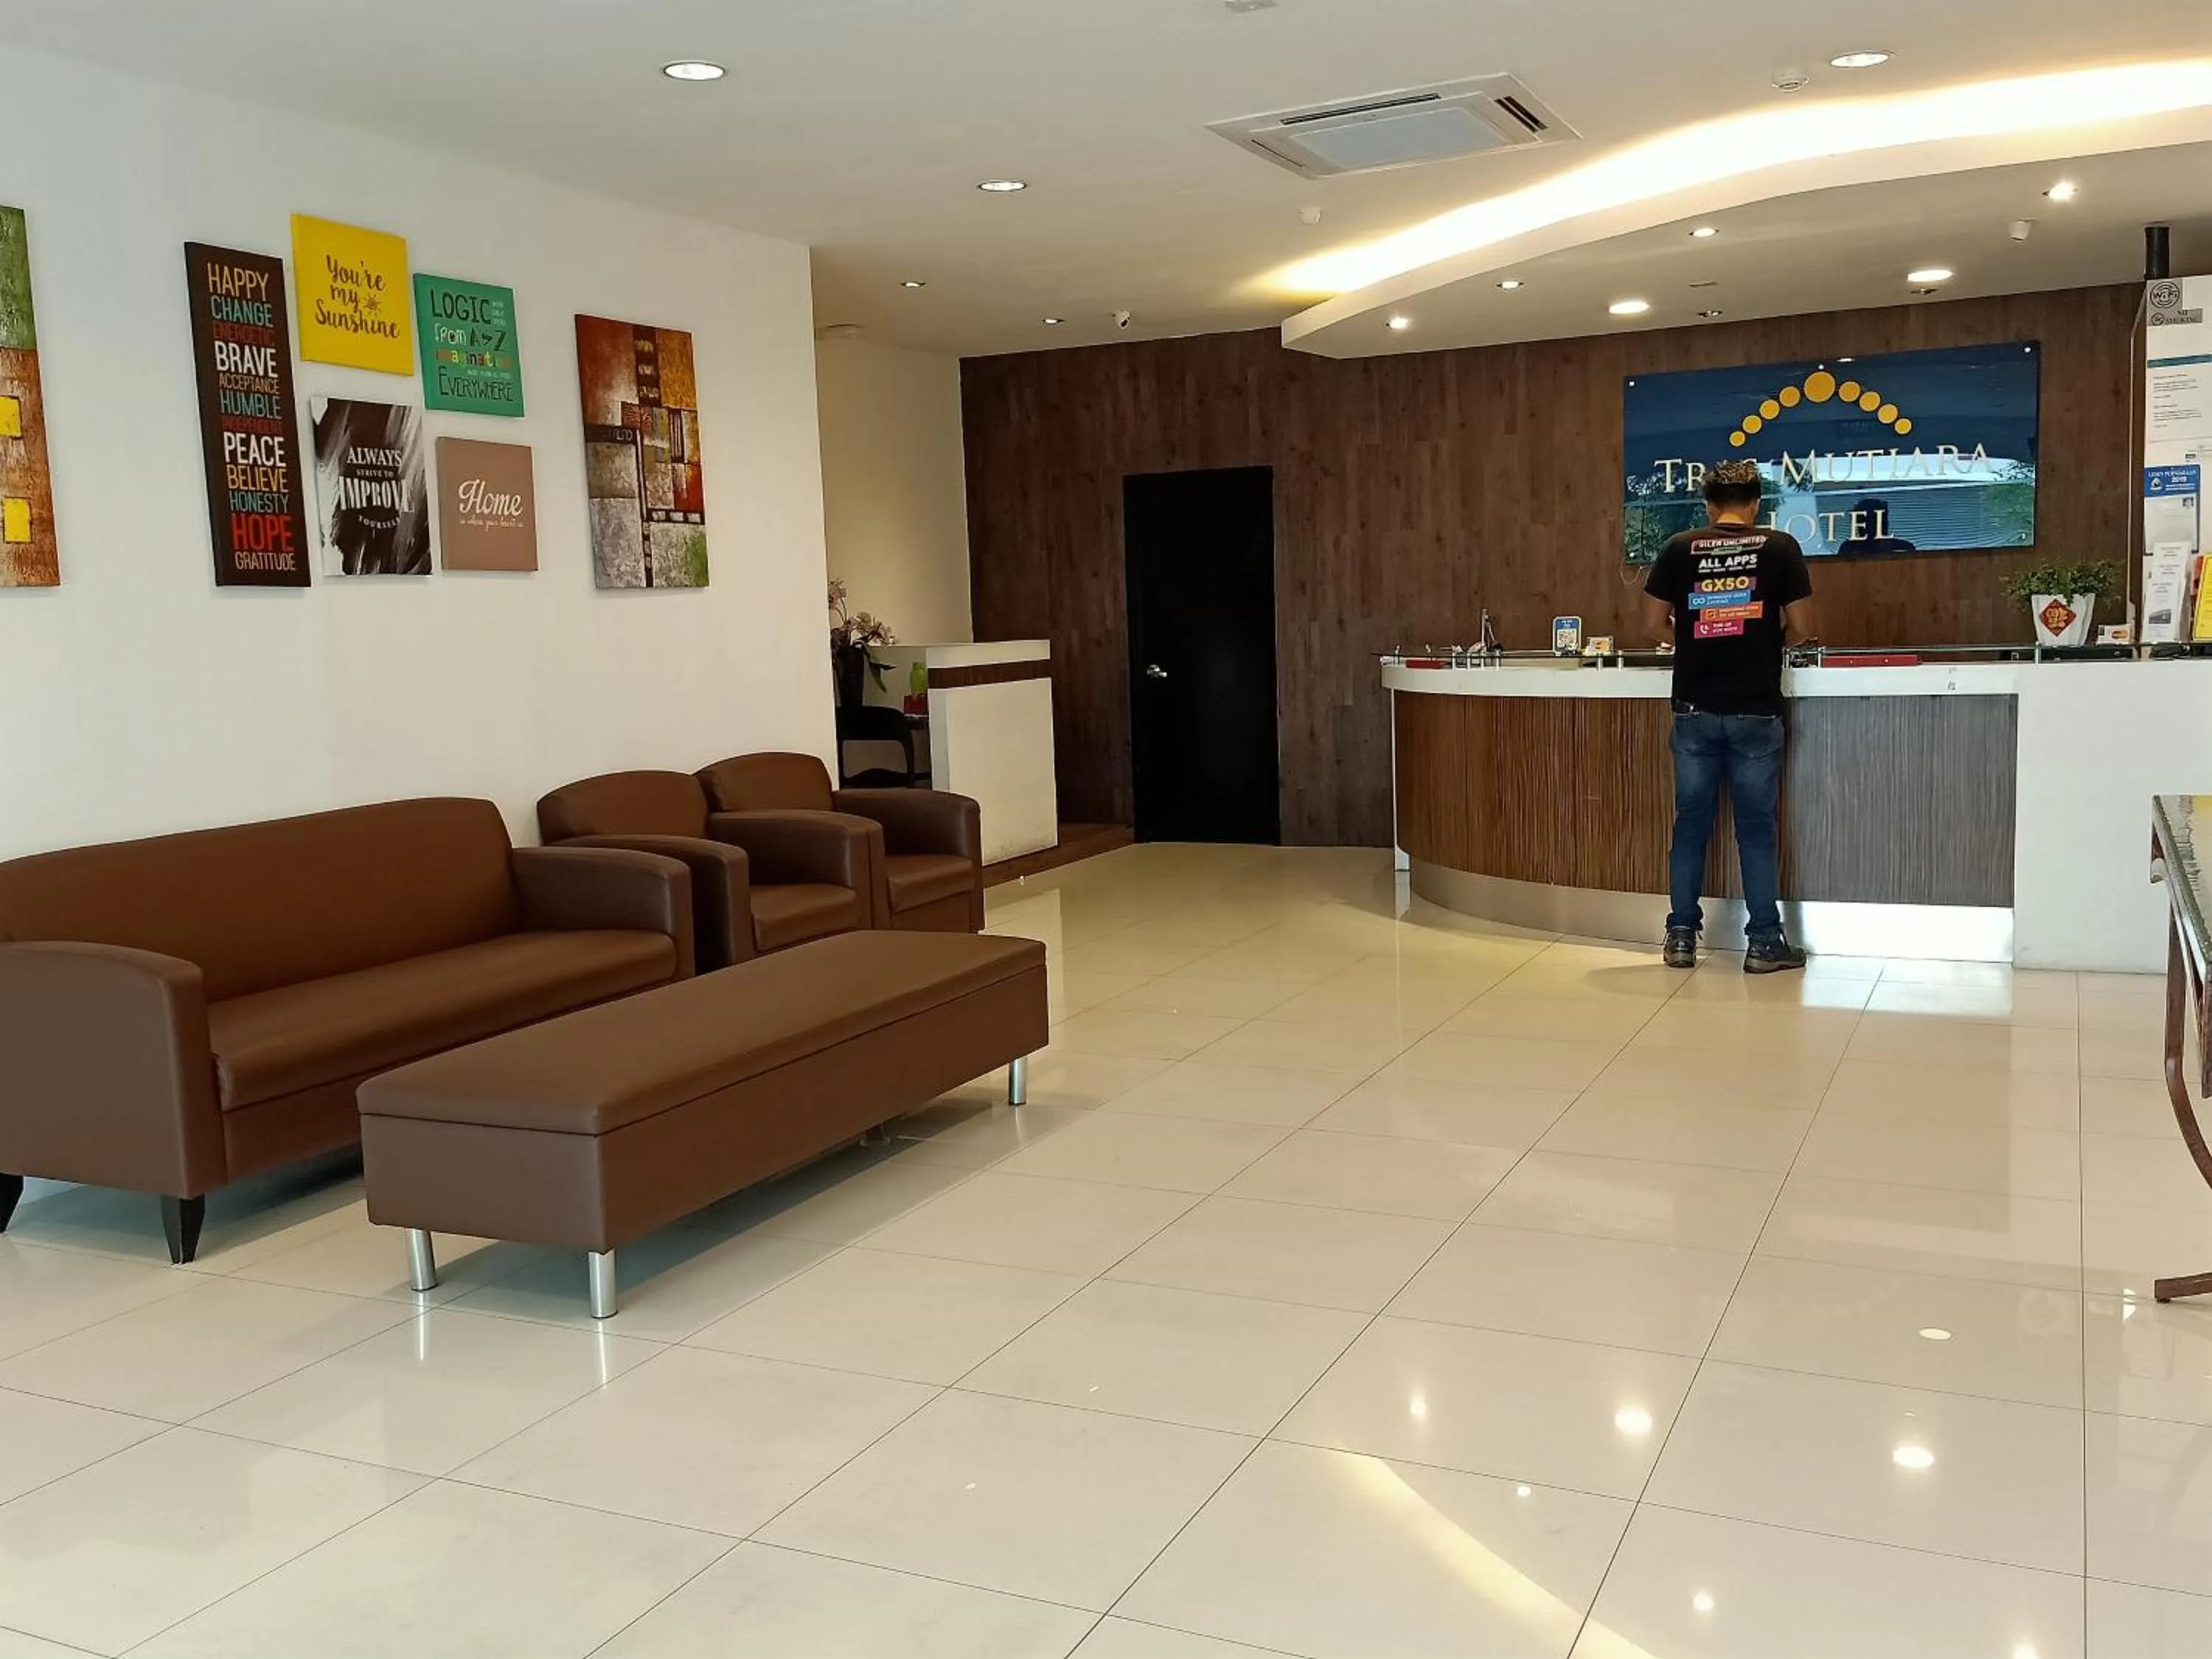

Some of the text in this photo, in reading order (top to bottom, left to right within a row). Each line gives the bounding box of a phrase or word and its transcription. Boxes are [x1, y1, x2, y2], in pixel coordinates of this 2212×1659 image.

[207, 262, 268, 301] HAPPY
[326, 254, 386, 291] You're
[211, 295, 274, 327] CHANGE
[330, 284, 360, 313] my
[430, 287, 492, 325] LOGIC
[316, 298, 400, 338] Sunshine
[215, 341, 279, 378] BRAVE
[219, 372, 281, 394] ACCEPTANCE
[438, 366, 514, 402] EVERYWHERE
[220, 389, 282, 420] HUMBLE
[223, 431, 287, 467] PEACE
[347, 446, 402, 467] ALWAYS
[1781, 442, 1992, 484] MUTIARA
[226, 465, 289, 493] BELIEVE
[383, 470, 394, 478] TO
[229, 490, 289, 514] HONESTY
[338, 476, 415, 513] IMPROVE
[458, 479, 523, 517] Home
[231, 513, 294, 552] HOPE
[235, 551, 297, 571] GRATITUDE
[1698, 557, 1721, 568] ALL
[1725, 554, 1758, 567] APPS
[1701, 576, 1750, 592] GX50
